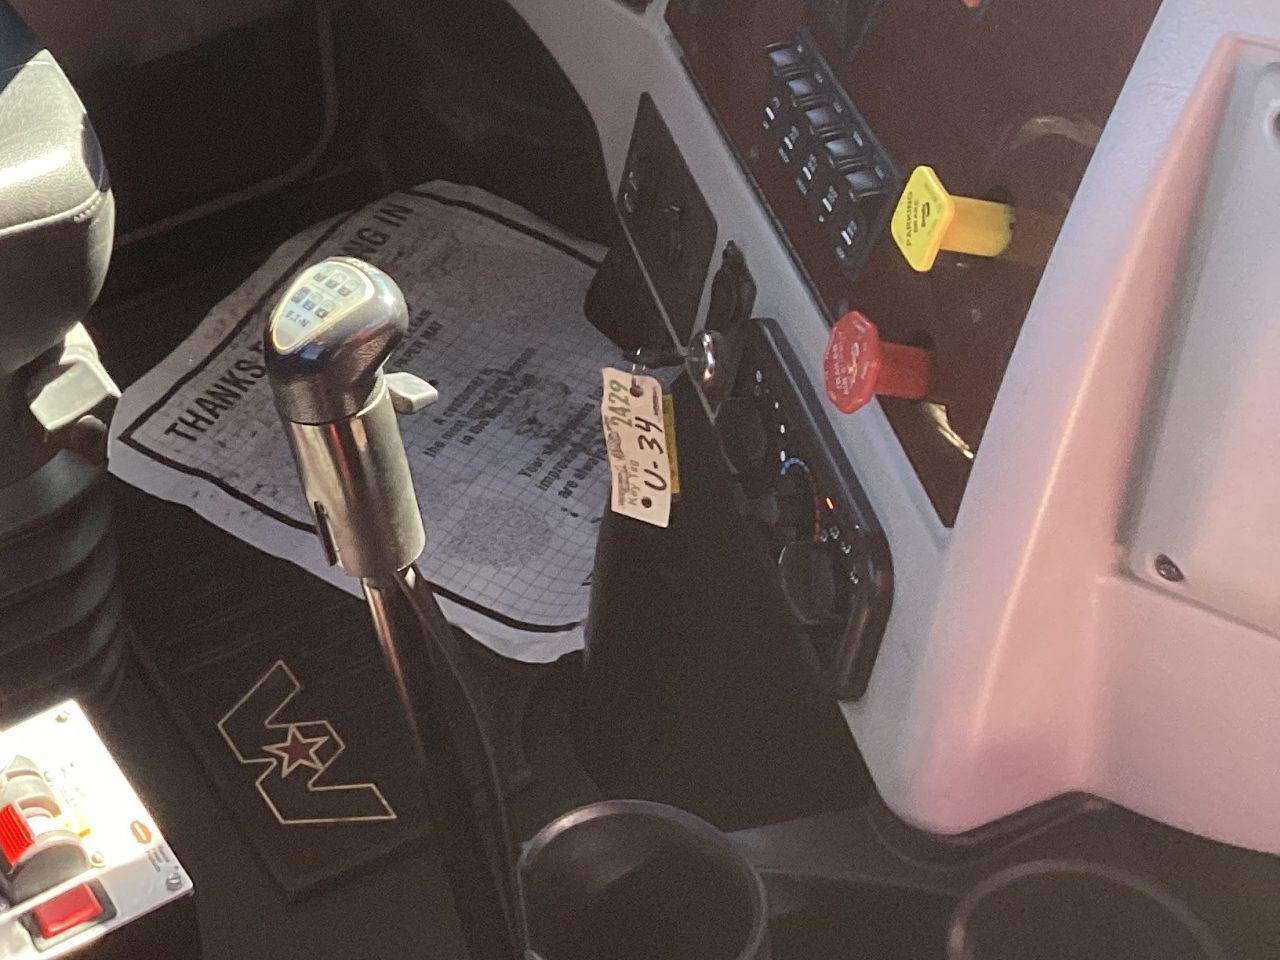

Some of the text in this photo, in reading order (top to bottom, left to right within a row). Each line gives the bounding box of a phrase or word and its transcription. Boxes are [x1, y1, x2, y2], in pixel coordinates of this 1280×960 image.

[906, 191, 914, 247] PARKING
[164, 202, 415, 442] THANKS IN
[608, 379, 633, 428] 2429
[424, 440, 446, 458] the
[518, 456, 545, 478] Your
[558, 480, 579, 499] are
[628, 459, 641, 506] Key Tag
